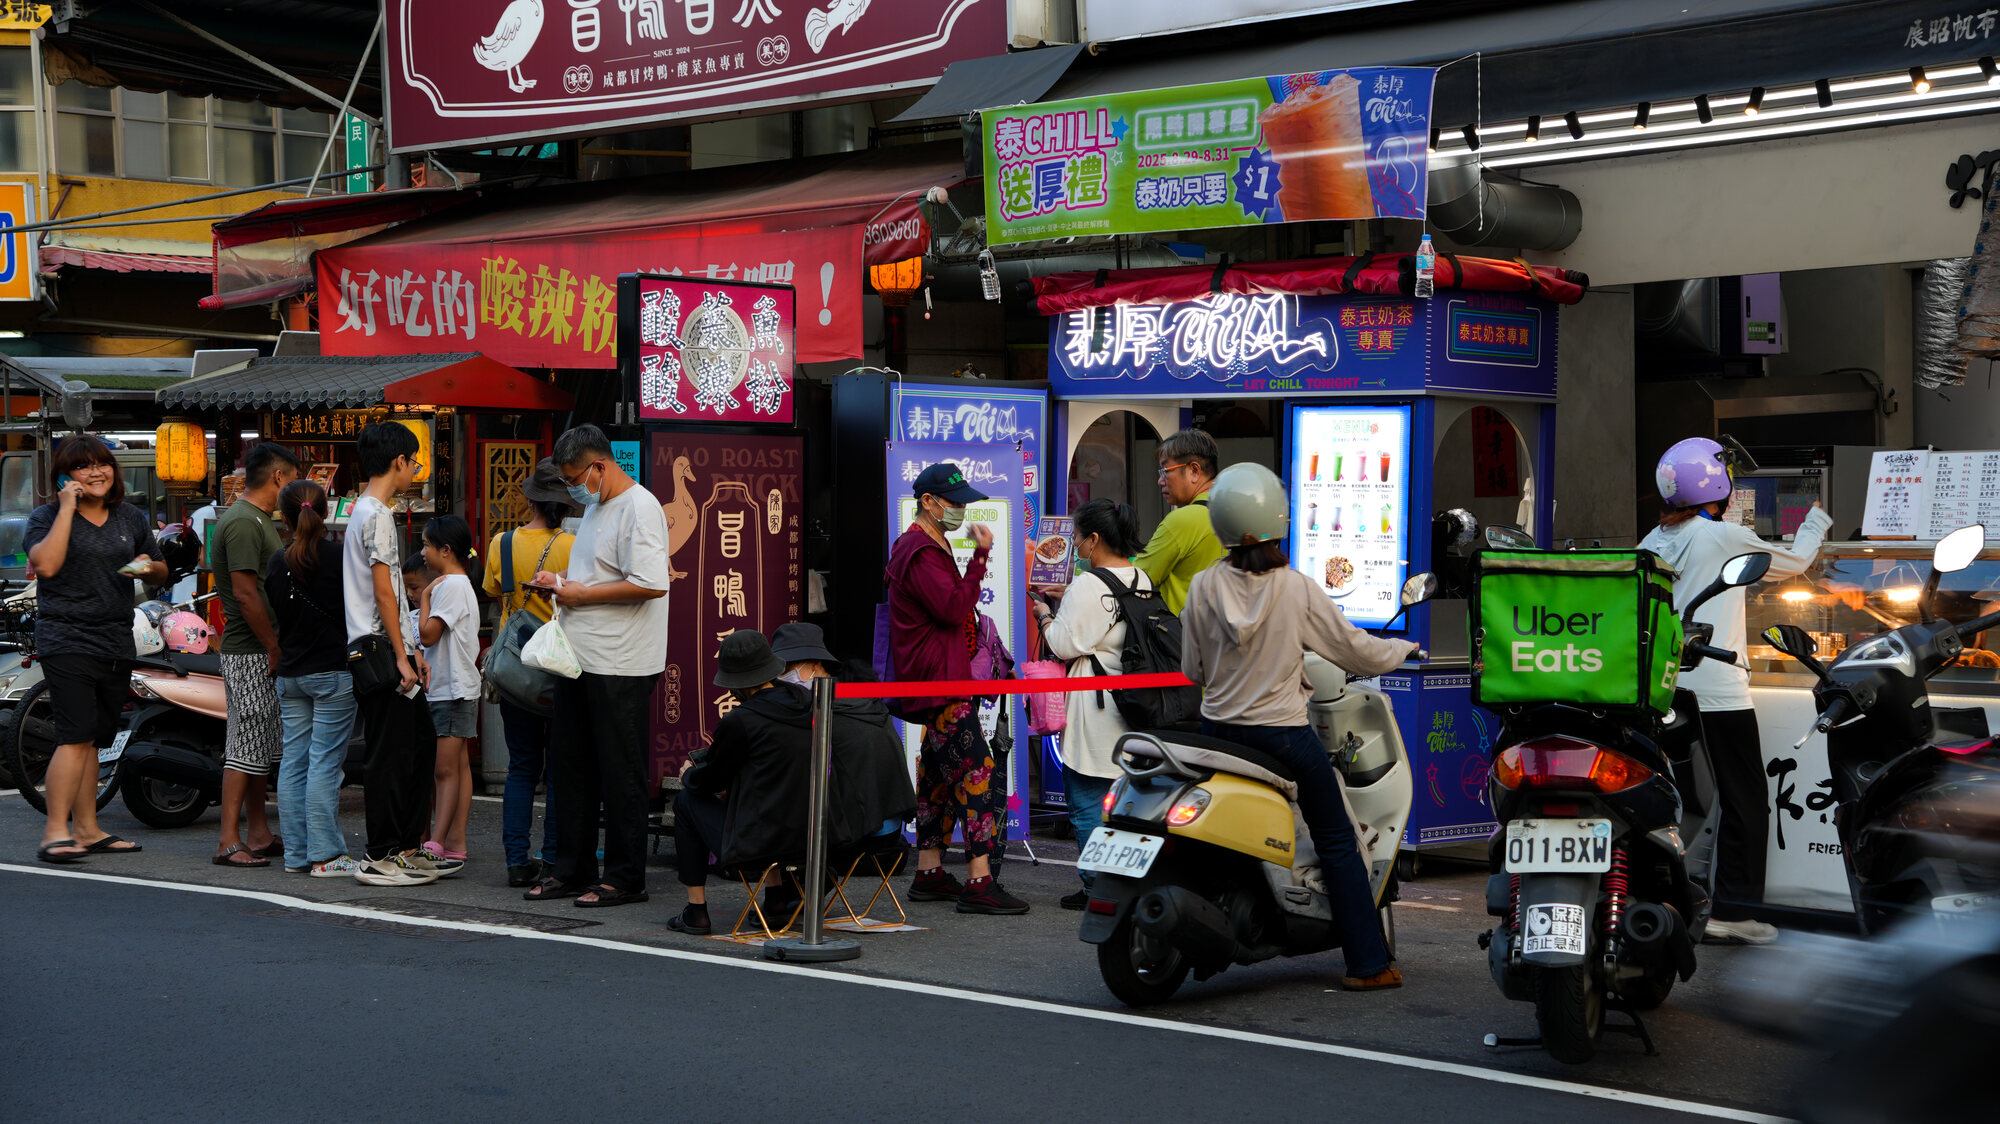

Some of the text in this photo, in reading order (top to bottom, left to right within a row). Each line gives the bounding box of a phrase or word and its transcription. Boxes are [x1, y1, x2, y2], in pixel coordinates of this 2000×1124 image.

[653, 46, 691, 59] SINCE 2024
[1373, 74, 1406, 95] 泰厚
[999, 151, 1107, 223] 送厚禮
[1135, 173, 1228, 210] 泰奶只要
[1244, 165, 1270, 201] $1
[641, 288, 785, 355] 酸菜魚
[1340, 304, 1414, 328] 泰式奶茶
[1357, 329, 1394, 351] 專賣
[1458, 321, 1530, 346] 泰式奶茶專賣
[641, 351, 791, 415] 酸辣粉
[1245, 377, 1360, 390] LET CHILL TONIGHT
[615, 450, 635, 460] Uber
[721, 448, 799, 468] ROAST
[710, 473, 800, 503] DUCK
[962, 540, 977, 548] NO.
[788, 514, 799, 624] 成都冒烤鴨·酸
[982, 590, 990, 602] 2
[1513, 605, 1604, 636] Uber
[1511, 641, 1604, 672] Eats
[1081, 840, 1155, 871] 261-PDW
[1509, 837, 1608, 864] 011-BXW
[1808, 842, 1843, 855] FRIED
